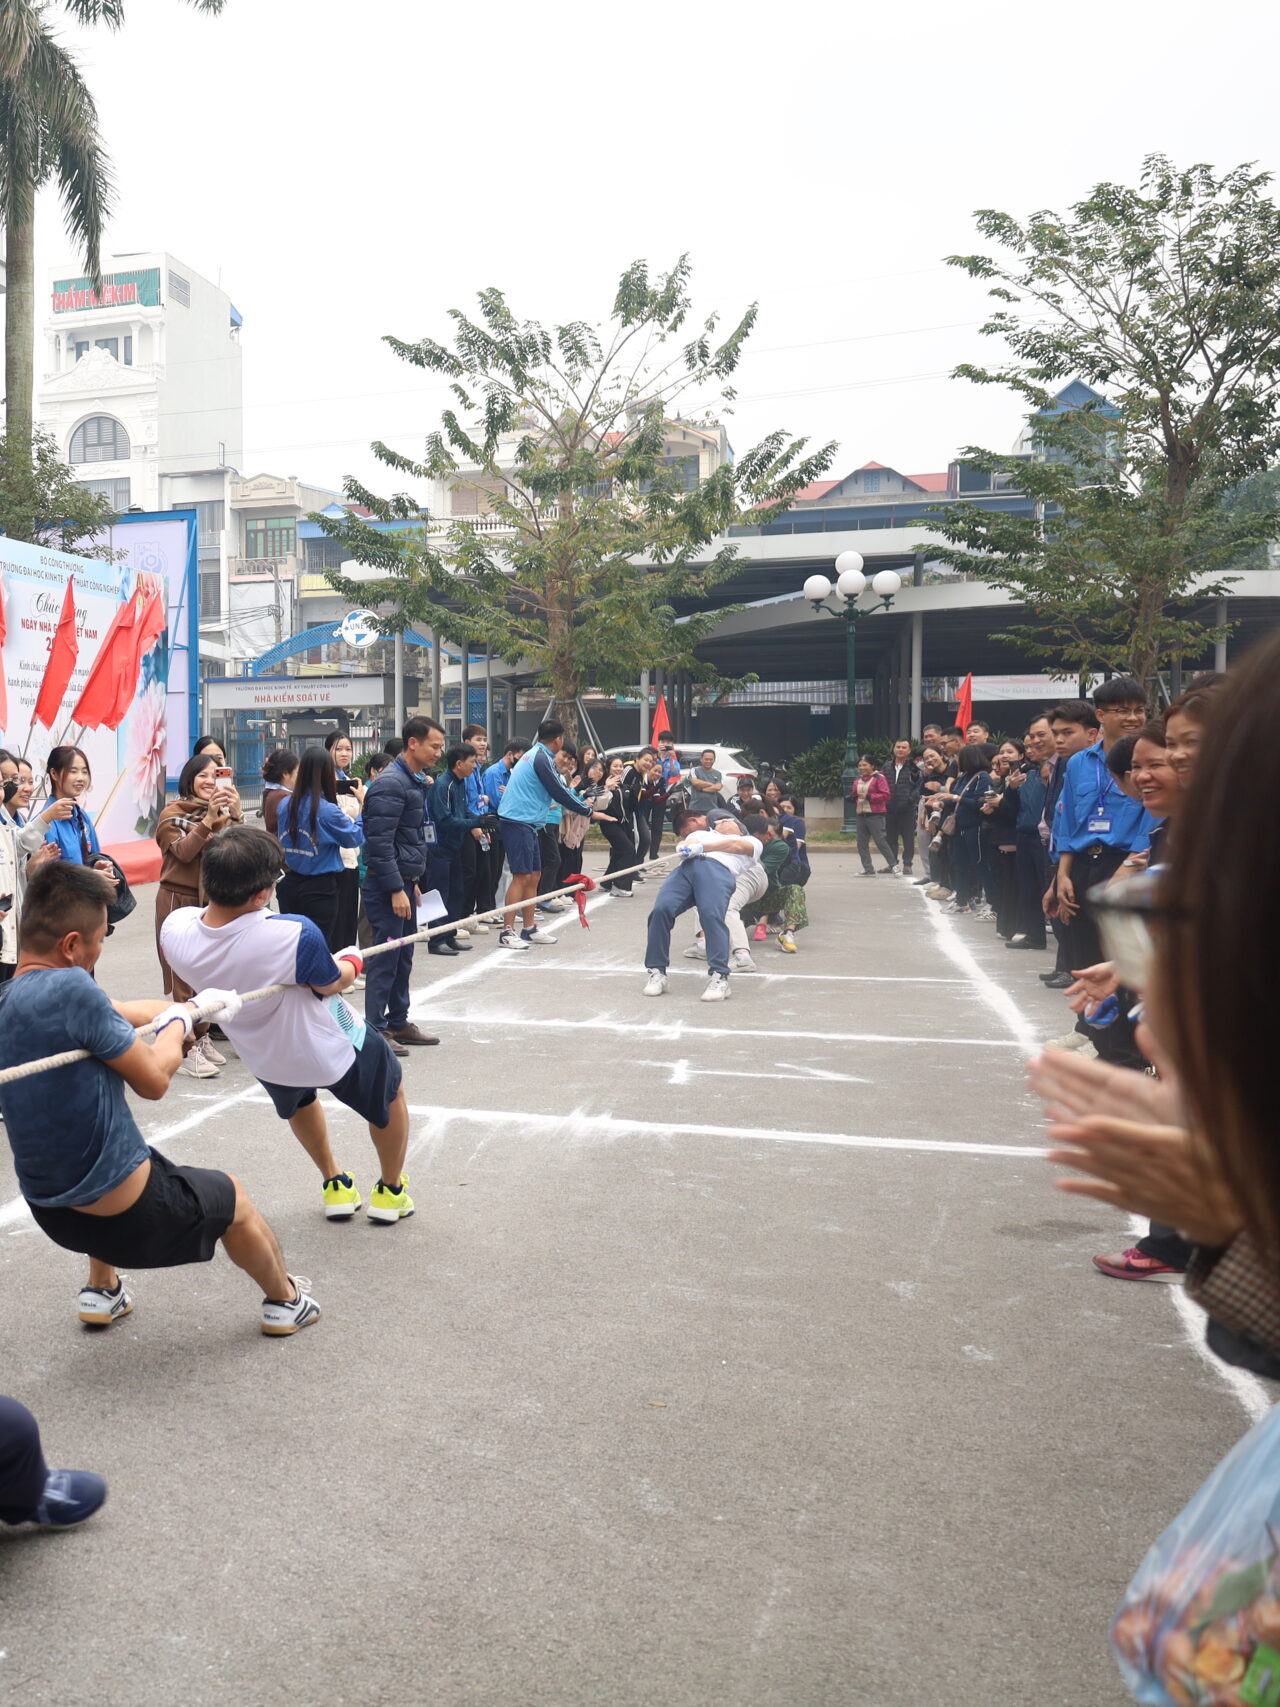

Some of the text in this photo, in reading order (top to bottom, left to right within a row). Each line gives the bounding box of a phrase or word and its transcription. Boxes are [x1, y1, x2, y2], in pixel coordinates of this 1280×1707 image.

[85, 628, 98, 640] NAM
[254, 693, 272, 703] NHÀ
[296, 692, 317, 702] SOÁT
